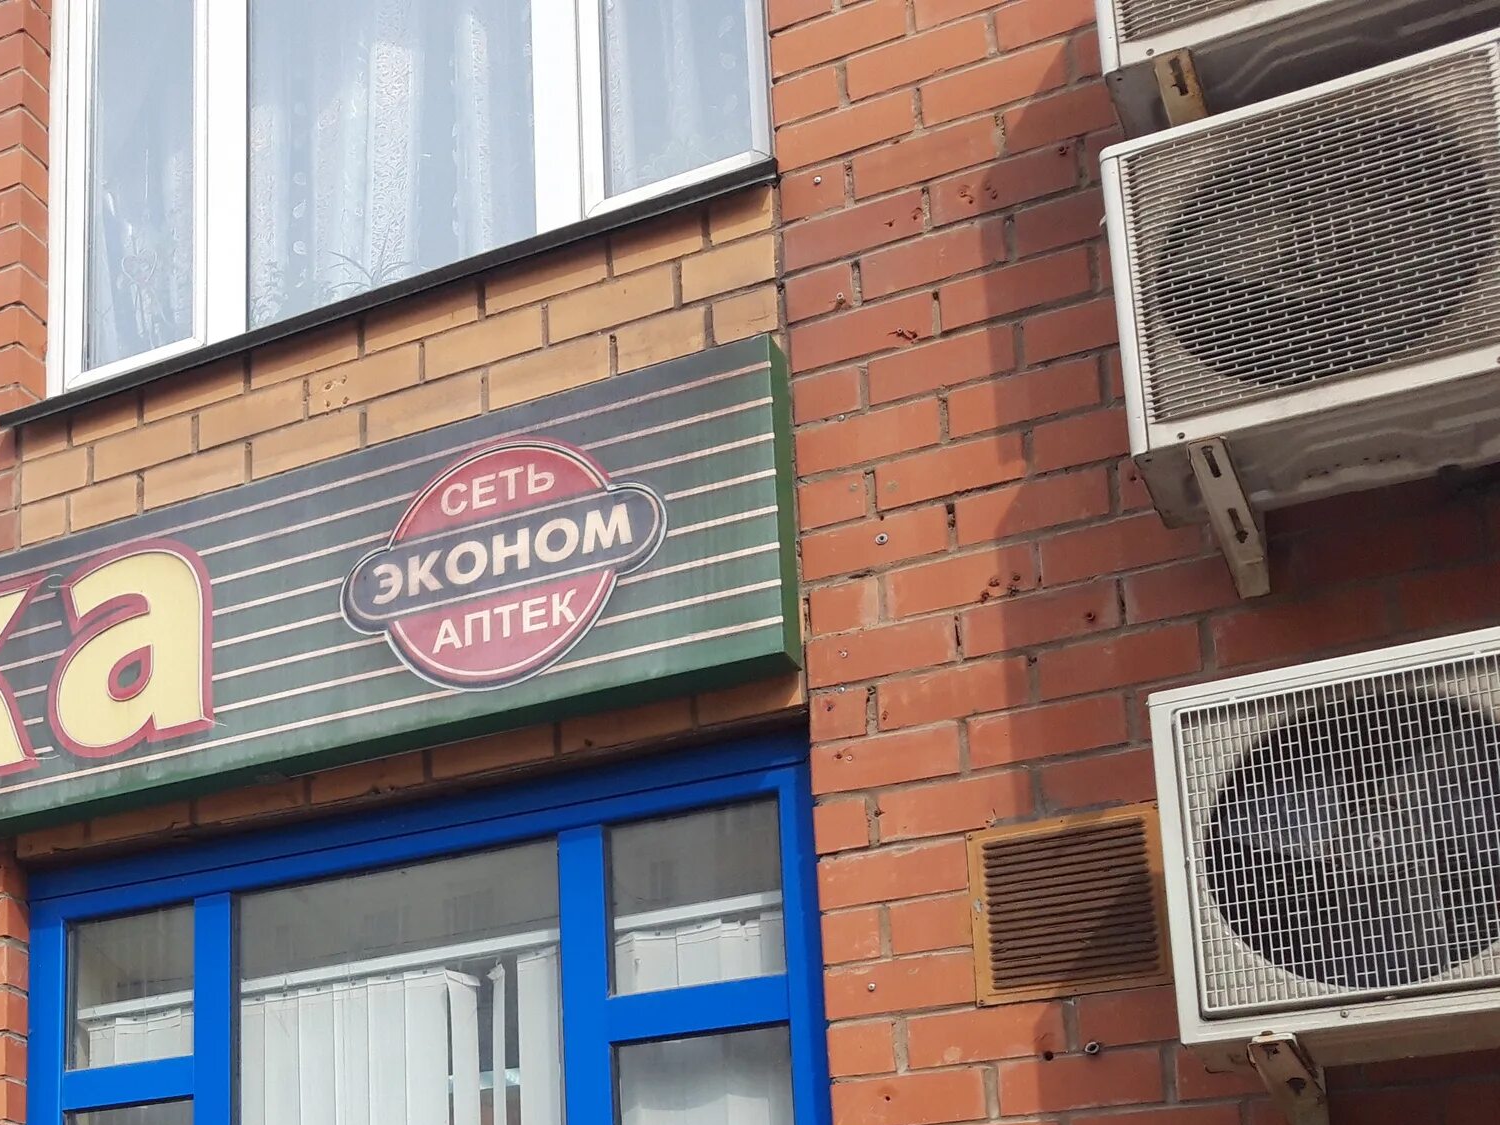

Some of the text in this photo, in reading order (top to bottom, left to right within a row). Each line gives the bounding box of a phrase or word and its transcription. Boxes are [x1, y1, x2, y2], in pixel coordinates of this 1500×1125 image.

[440, 463, 556, 517] СЕТЬ
[372, 503, 634, 606] ЭКОНОМ
[432, 588, 578, 654] АПТЕК
